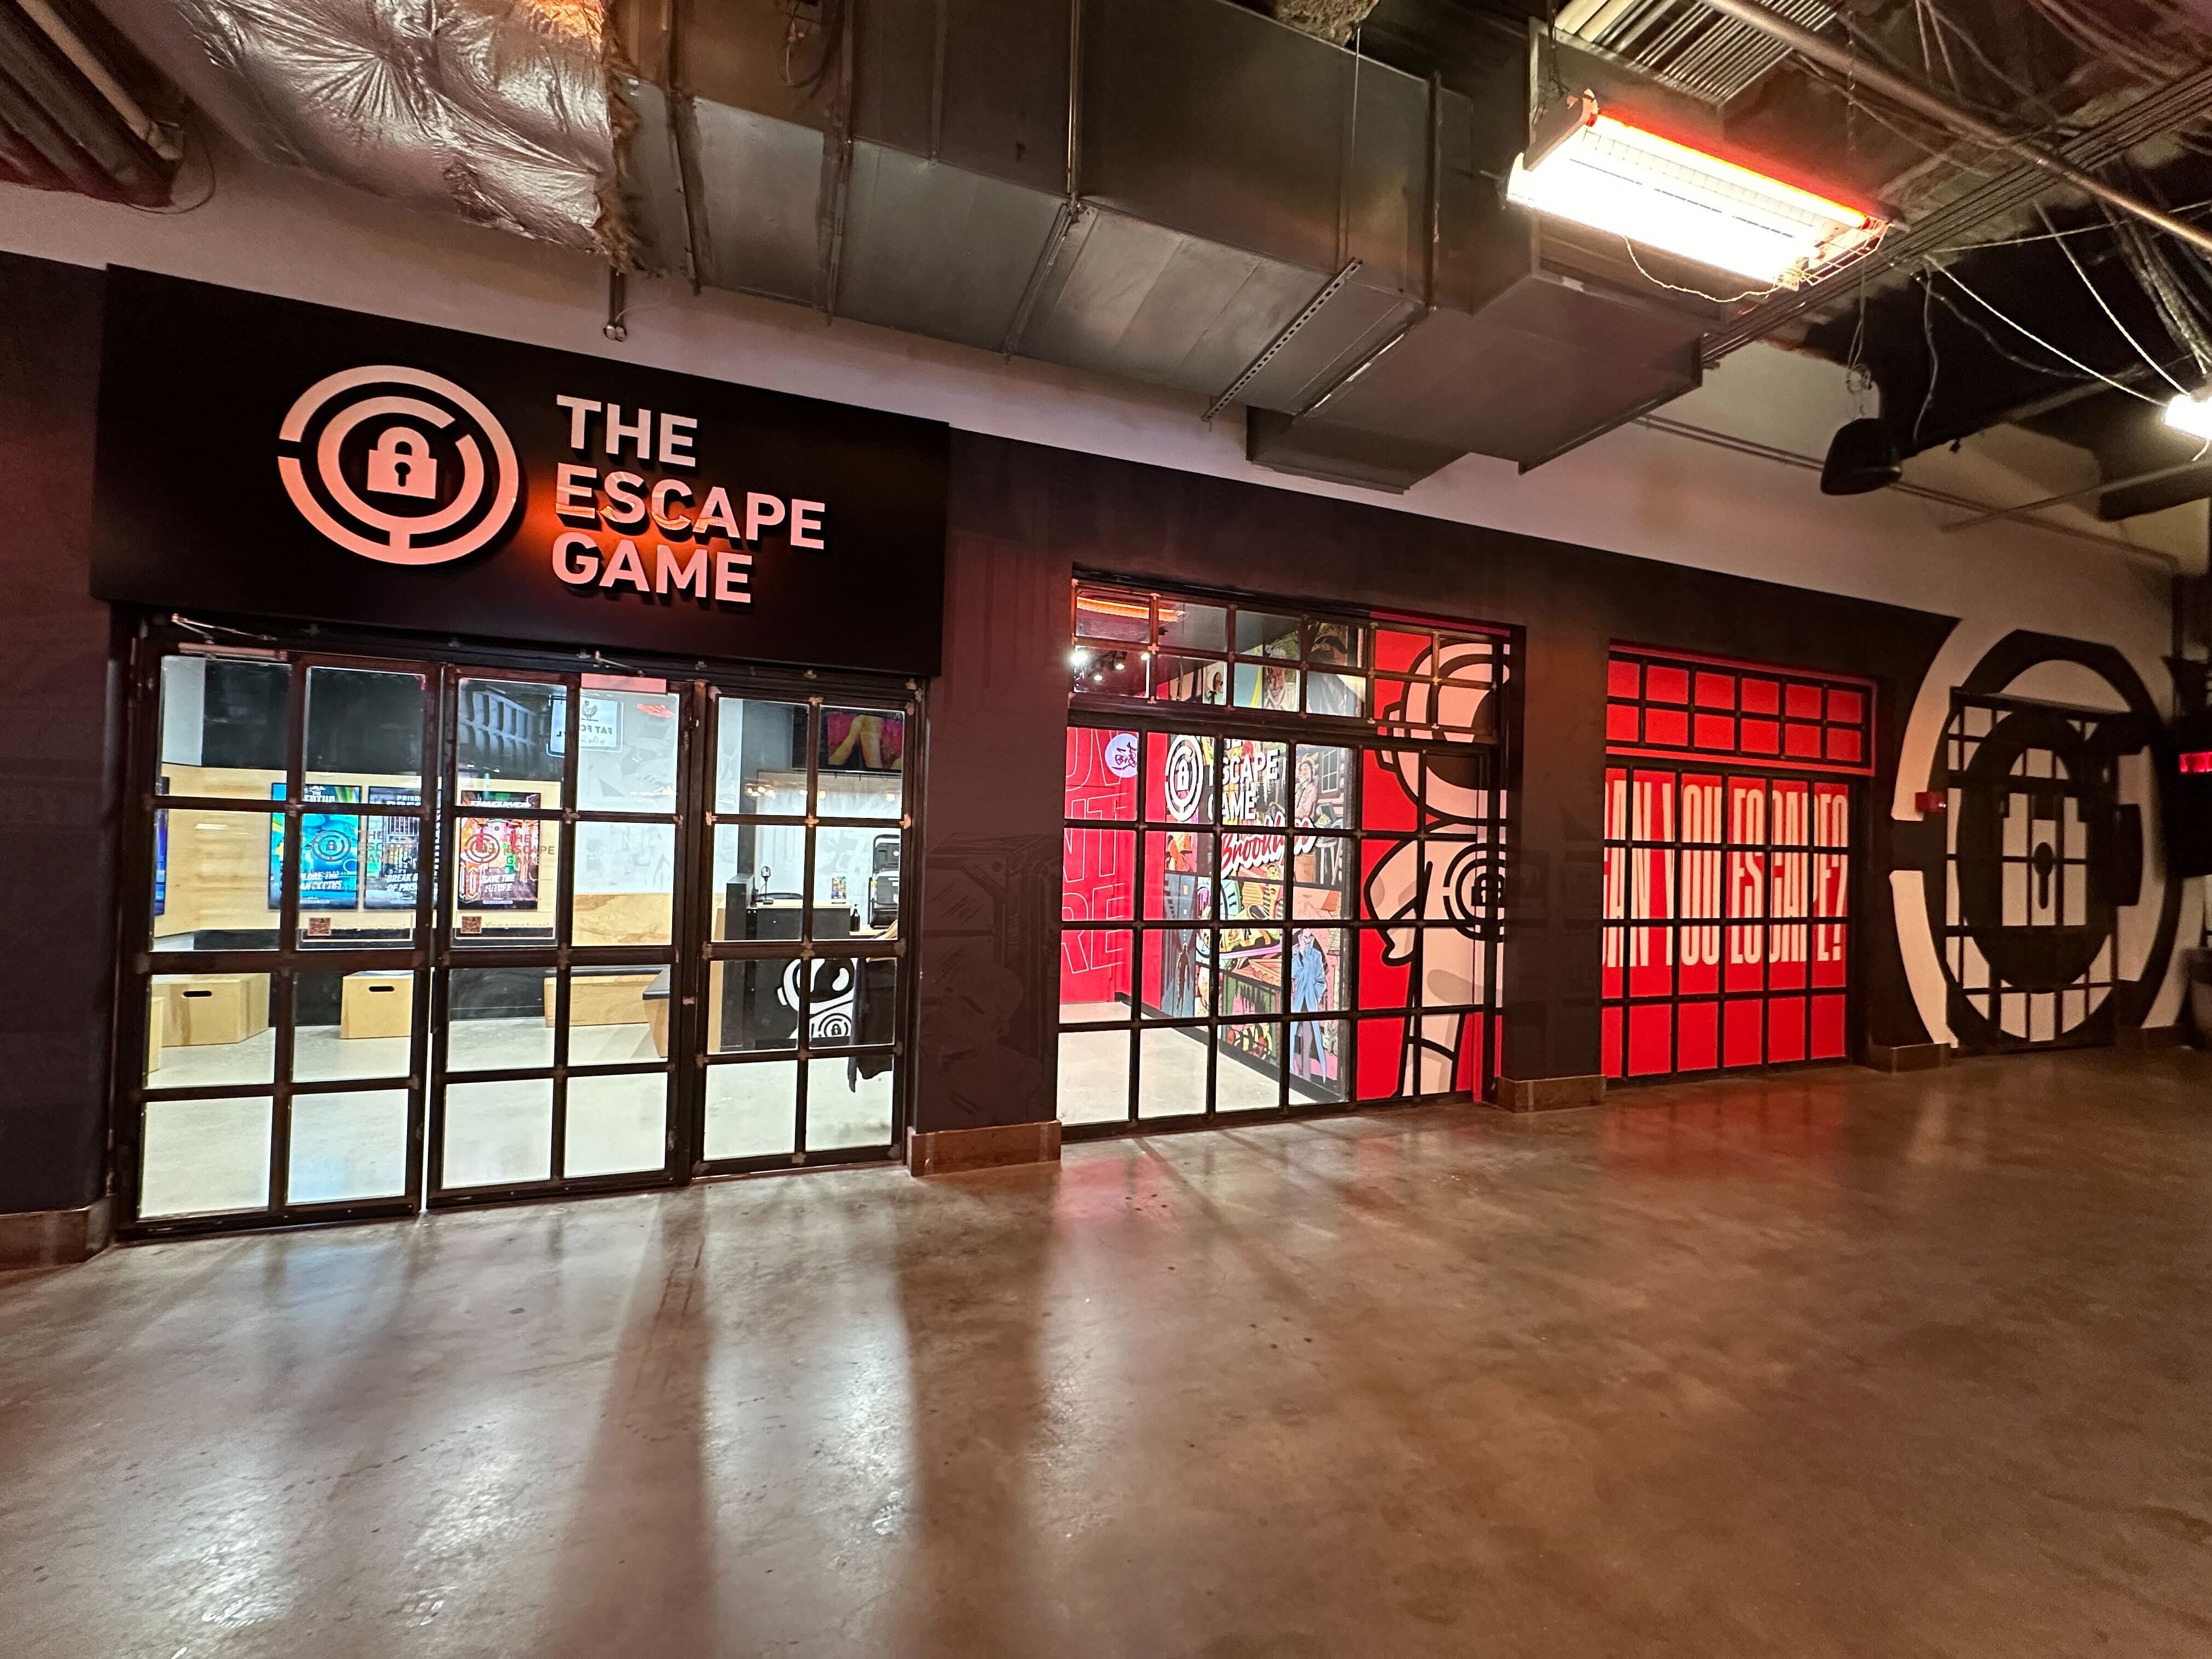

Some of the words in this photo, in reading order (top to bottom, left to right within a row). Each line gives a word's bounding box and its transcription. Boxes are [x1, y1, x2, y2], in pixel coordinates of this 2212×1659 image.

[557, 394, 697, 467] THE
[555, 462, 825, 549] ESCAPE
[552, 532, 752, 603] GAME
[504, 845, 555, 855] ESCAPE
[1221, 811, 1317, 878] Brookln
[1602, 780, 1651, 968] AN
[1731, 788, 1848, 964] ESCAPE?
